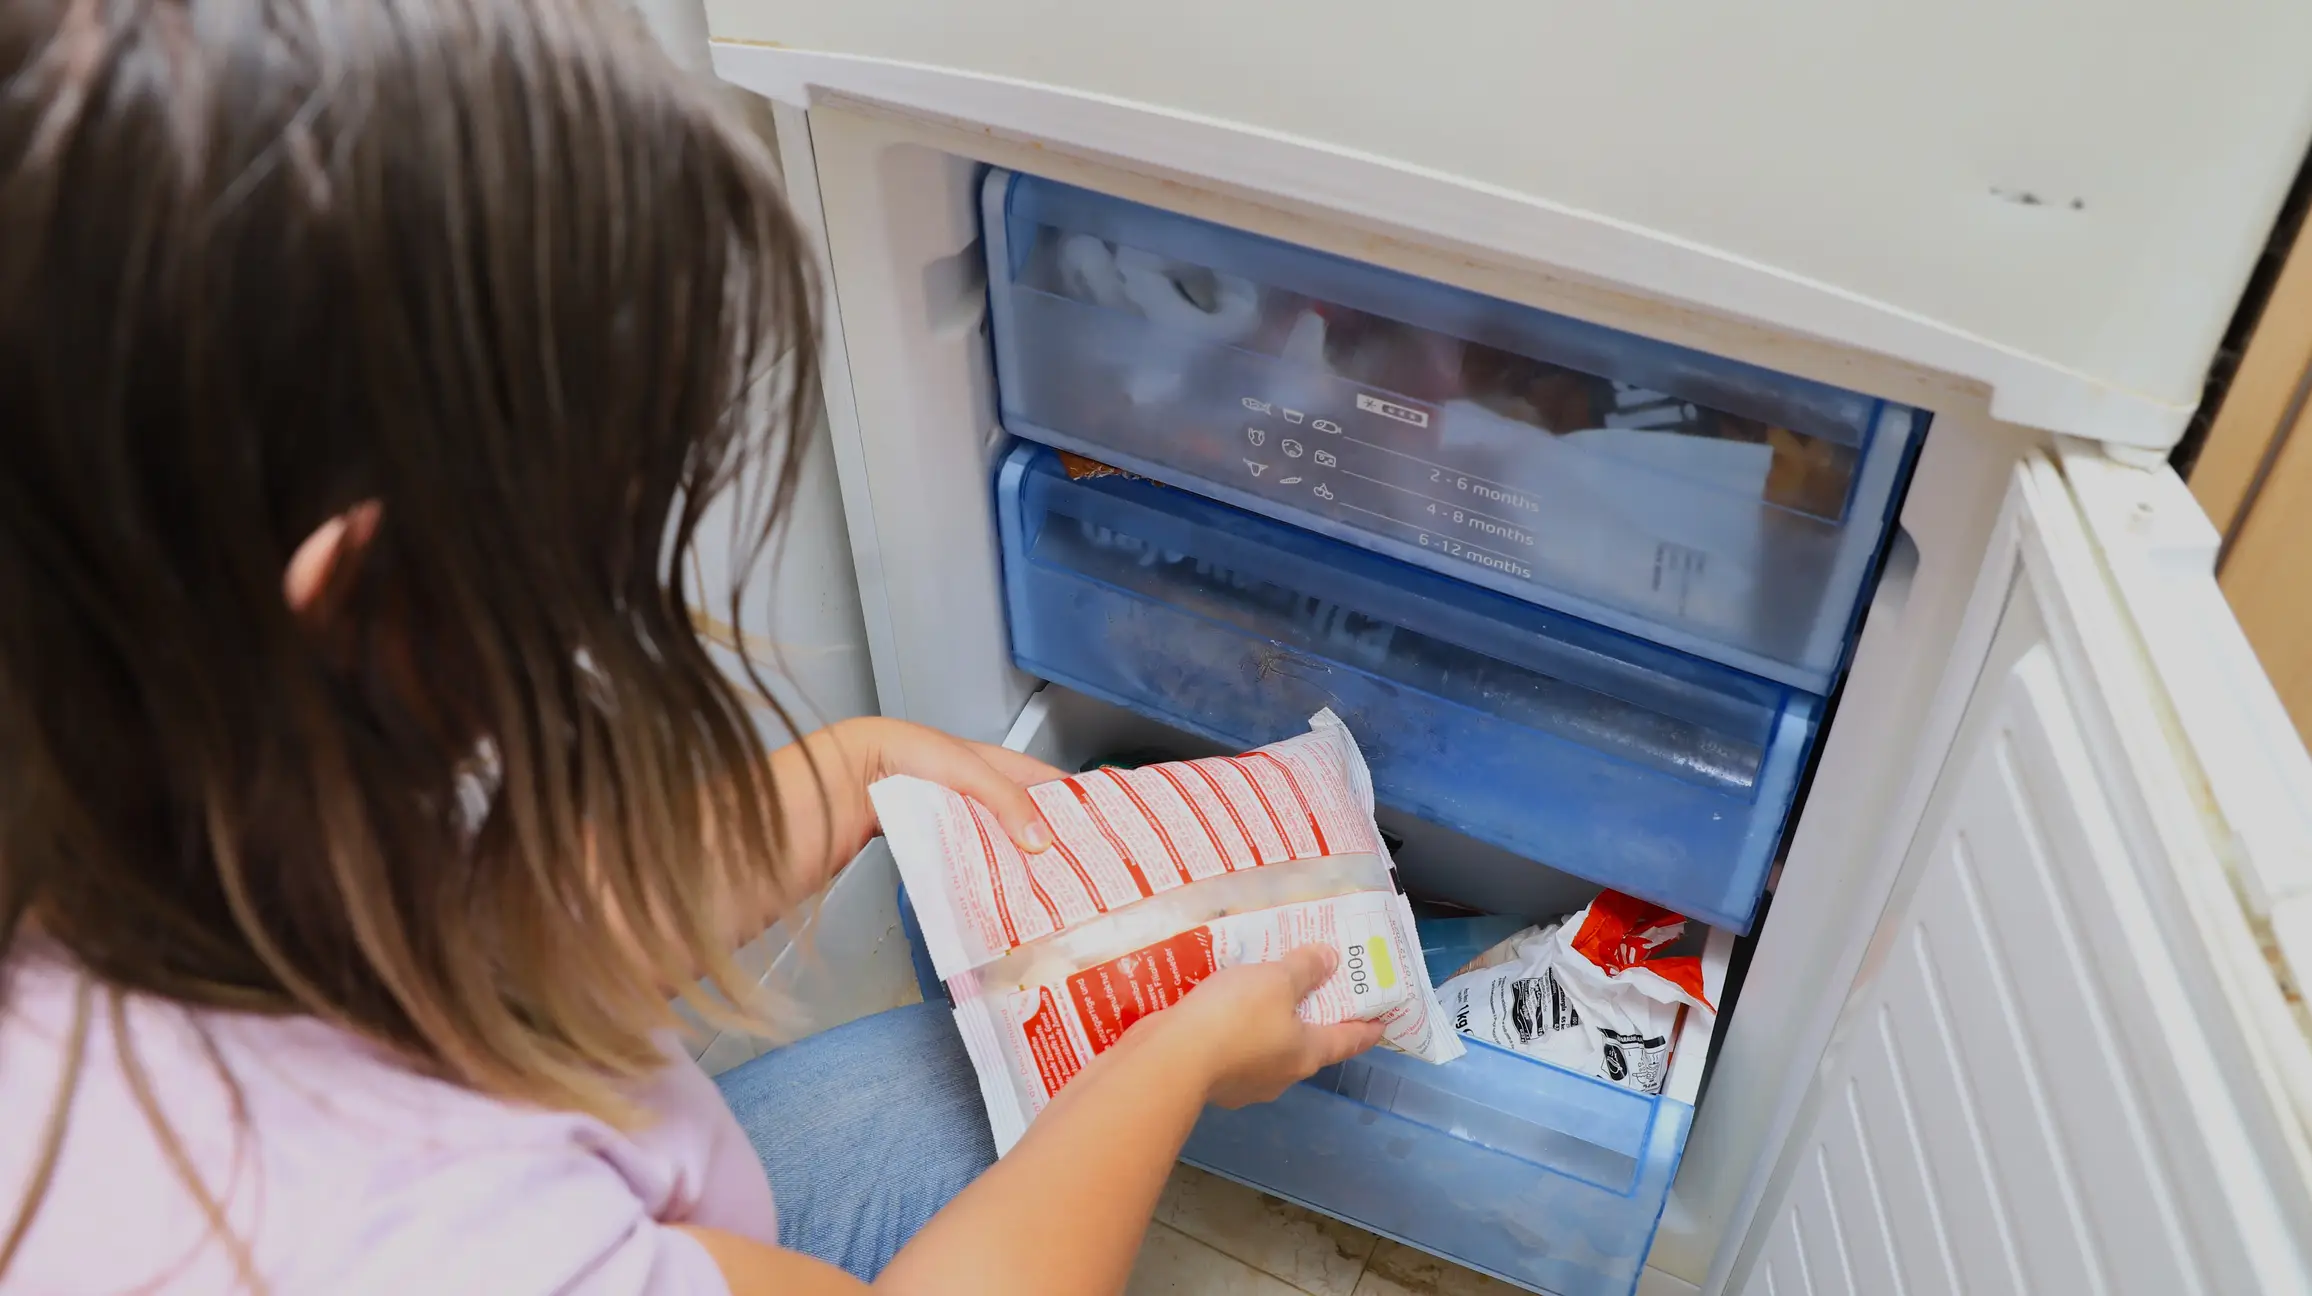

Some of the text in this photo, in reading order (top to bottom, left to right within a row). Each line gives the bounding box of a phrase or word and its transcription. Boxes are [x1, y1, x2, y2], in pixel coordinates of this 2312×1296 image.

[1430, 468, 1440, 482] 2
[1457, 477, 1468, 490] 6
[1473, 484, 1539, 512] months
[1426, 503, 1436, 515] 4
[1453, 510, 1464, 523] 8
[1468, 518, 1534, 546] months
[1419, 533, 1429, 545] 6
[1466, 551, 1531, 578] months
[1347, 943, 1369, 994] 900g
[1076, 978, 1108, 1044] einzigartige und
[1099, 971, 1122, 1020] Manufaktur
[1145, 982, 1159, 1010] nserer
[1000, 1007, 1028, 1076] Deutschland
[1455, 1011, 1468, 1030] kg
